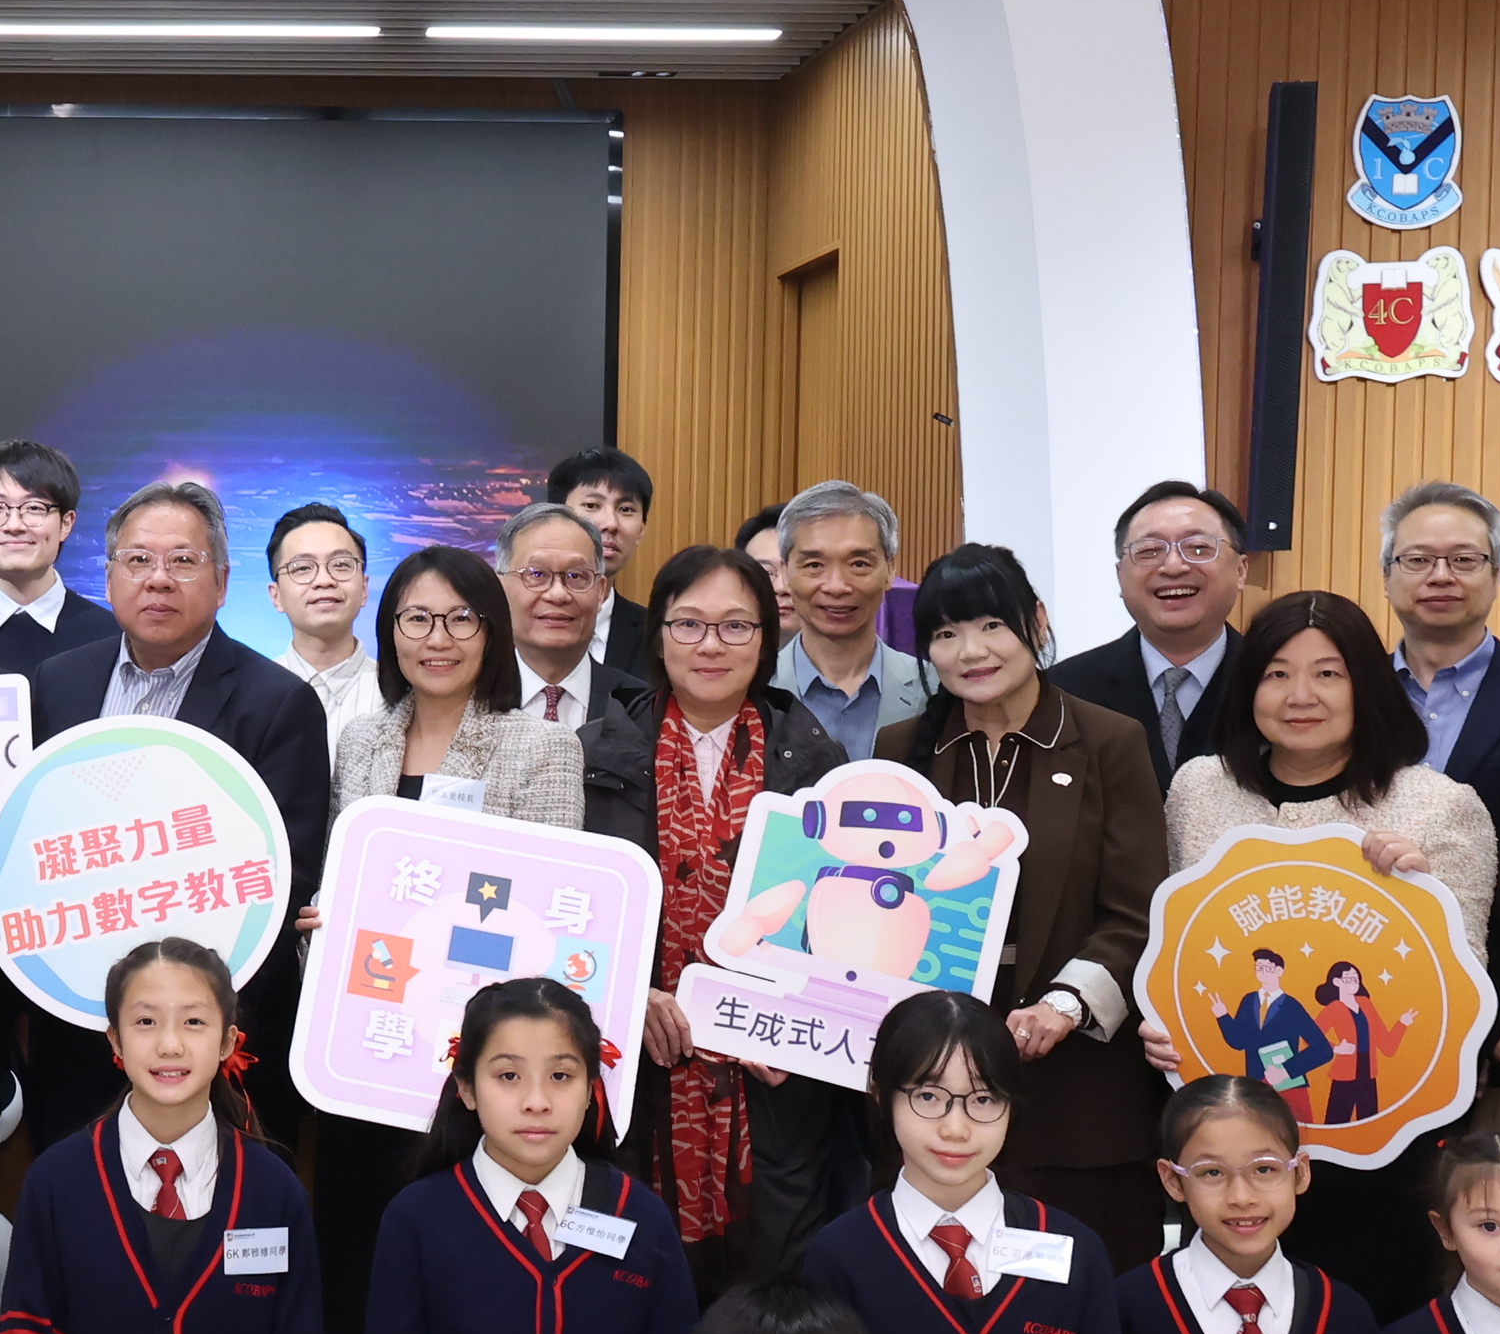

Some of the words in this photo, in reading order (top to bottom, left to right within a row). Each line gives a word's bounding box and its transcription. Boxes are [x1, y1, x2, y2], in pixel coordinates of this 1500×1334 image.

[1372, 158, 1383, 180] 1
[1425, 157, 1445, 180] C
[1368, 297, 1415, 325] 4C
[33, 804, 217, 880] 凝聚力量
[2, 859, 274, 955] 助力數字教育
[1228, 885, 1389, 944] 賦能教師
[714, 996, 877, 1066] 生成式人
[560, 1219, 575, 1231] 6C
[226, 1249, 240, 1260] 6K
